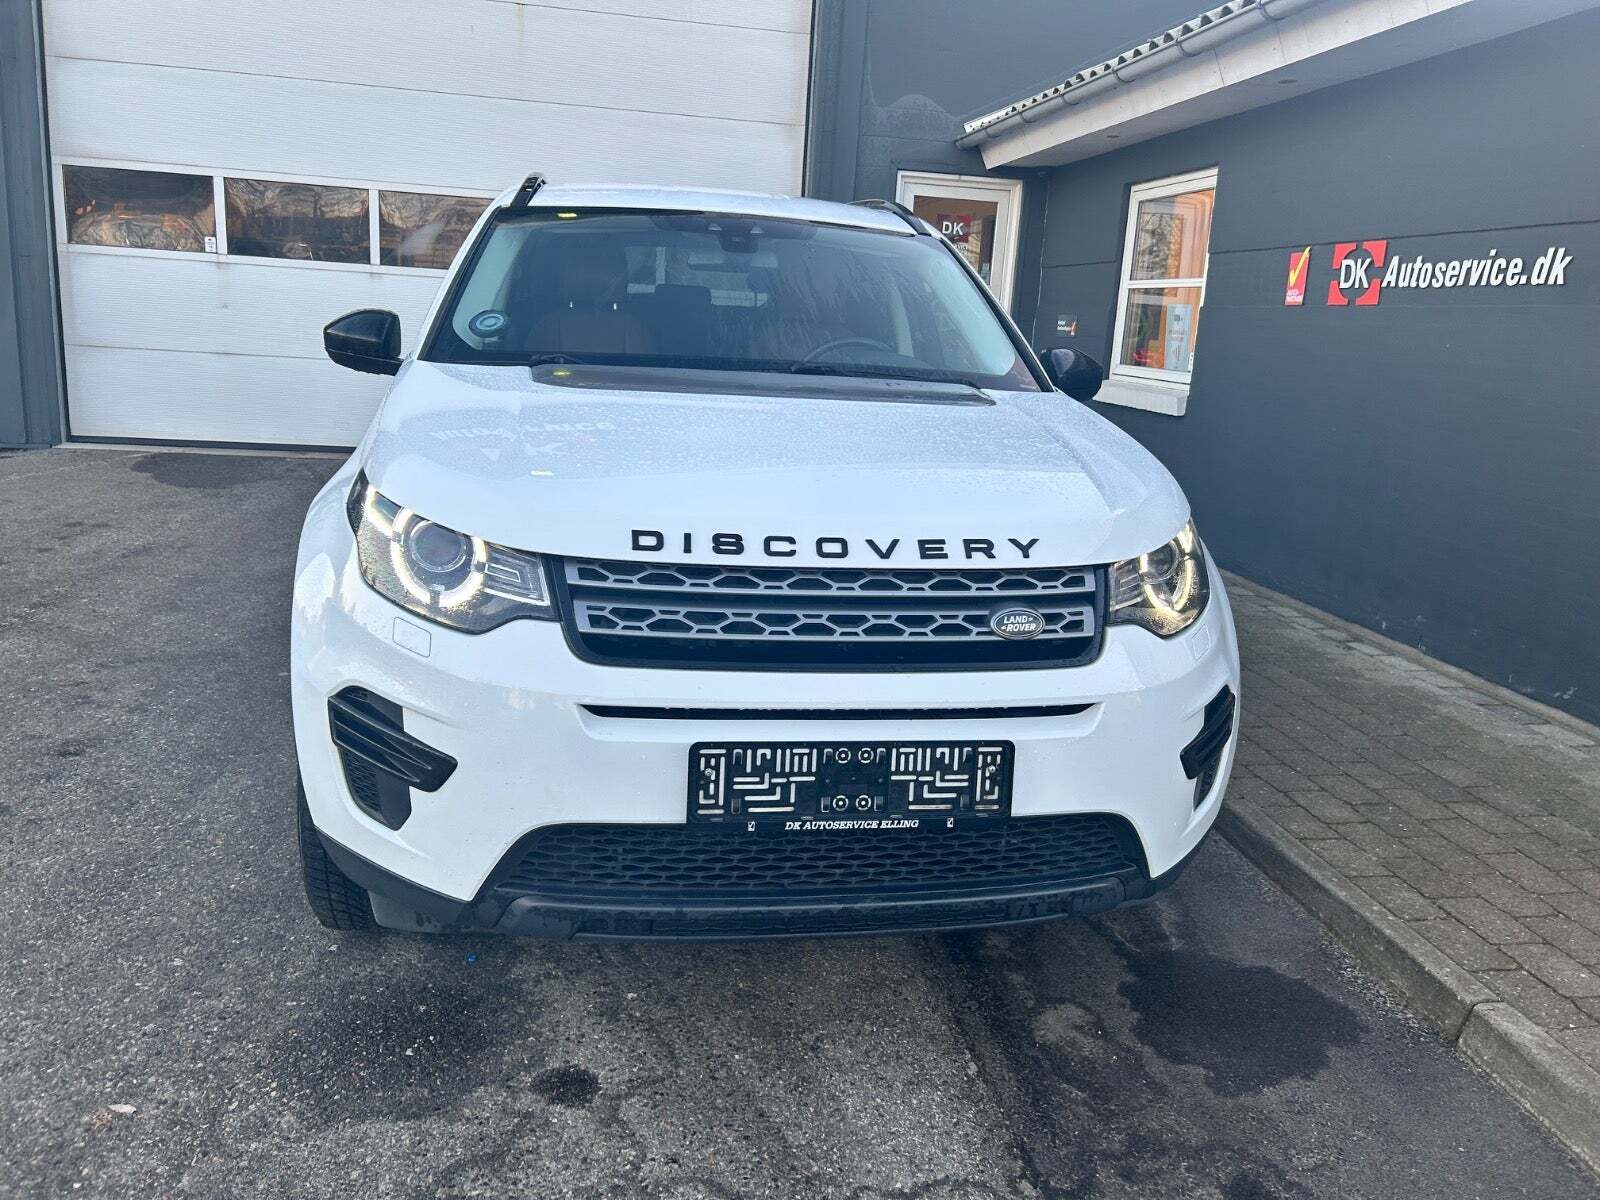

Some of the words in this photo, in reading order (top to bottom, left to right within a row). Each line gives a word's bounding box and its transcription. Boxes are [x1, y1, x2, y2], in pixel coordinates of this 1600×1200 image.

[942, 221, 964, 235] DK
[1339, 258, 1371, 289] DK
[1381, 247, 1573, 289] Autoservice.dk
[631, 530, 1040, 560] DISCOVERY
[1003, 615, 1028, 624] LAND
[1006, 623, 1036, 632] ROVER
[784, 821, 802, 830] DK
[802, 820, 879, 830] AUTOSERVICE
[880, 819, 920, 829] ELLING
